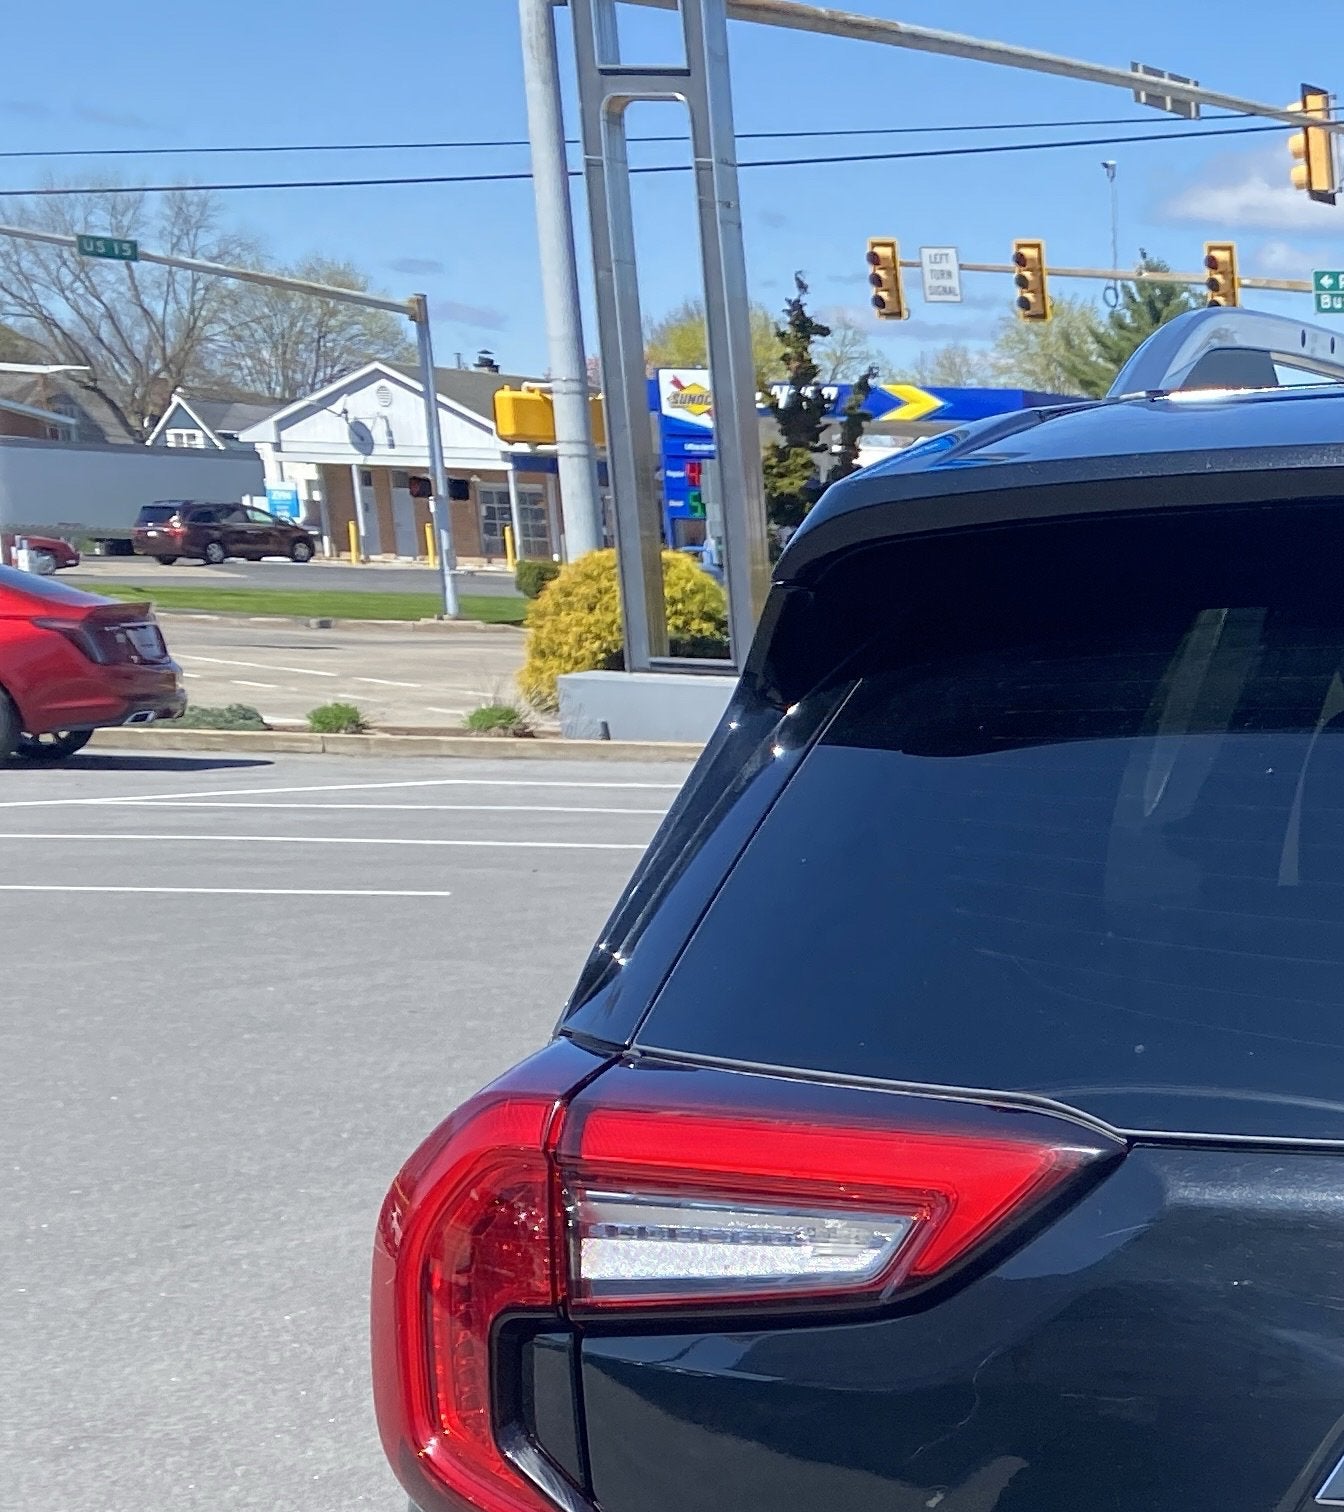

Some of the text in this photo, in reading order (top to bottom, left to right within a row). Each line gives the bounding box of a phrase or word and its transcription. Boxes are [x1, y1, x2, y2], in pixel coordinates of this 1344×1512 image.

[83, 239, 132, 256] US 15
[929, 253, 950, 264] LEFT
[930, 269, 953, 280] TURN
[928, 285, 959, 296] SIGNAL
